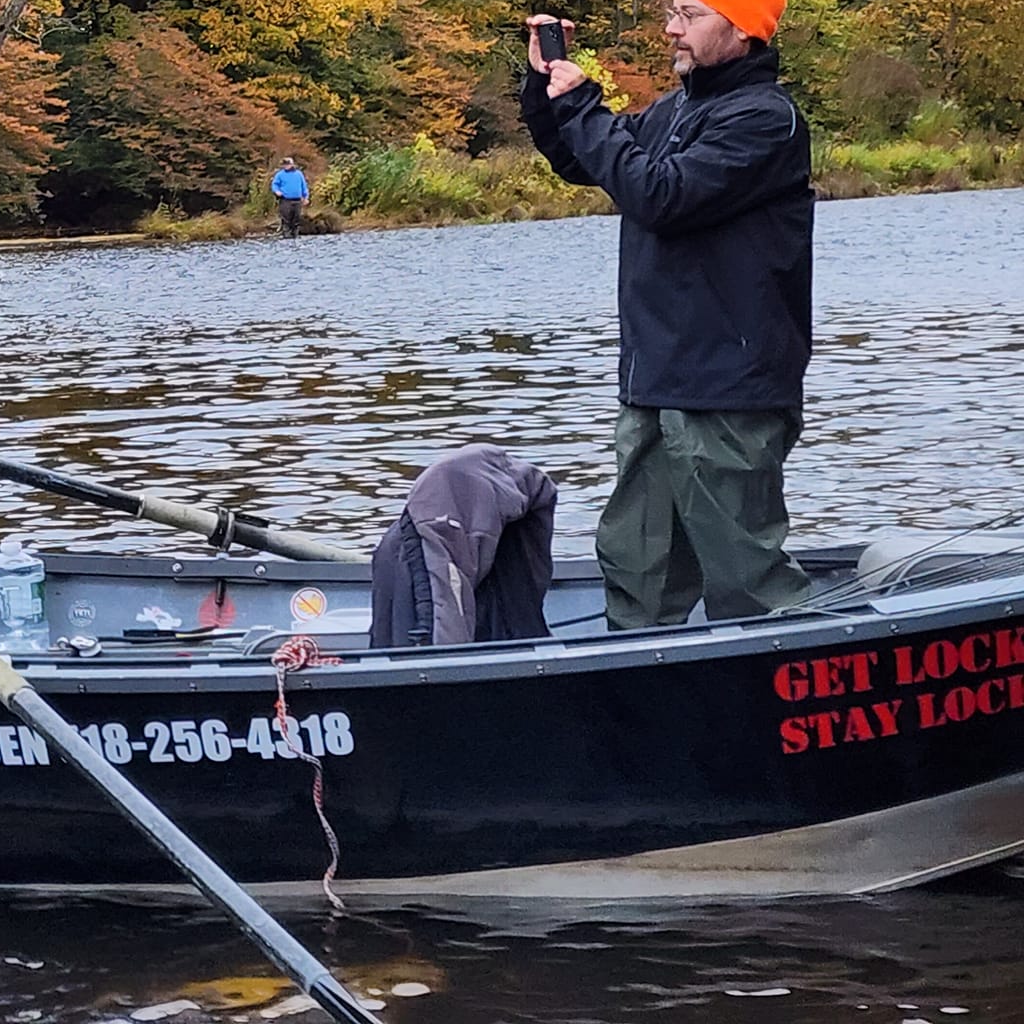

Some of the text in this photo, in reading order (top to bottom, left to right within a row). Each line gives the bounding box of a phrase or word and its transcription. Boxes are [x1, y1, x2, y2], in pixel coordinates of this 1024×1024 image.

[773, 652, 878, 701] GET
[69, 712, 355, 764] 18-256-4318
[779, 700, 902, 754] STAY
